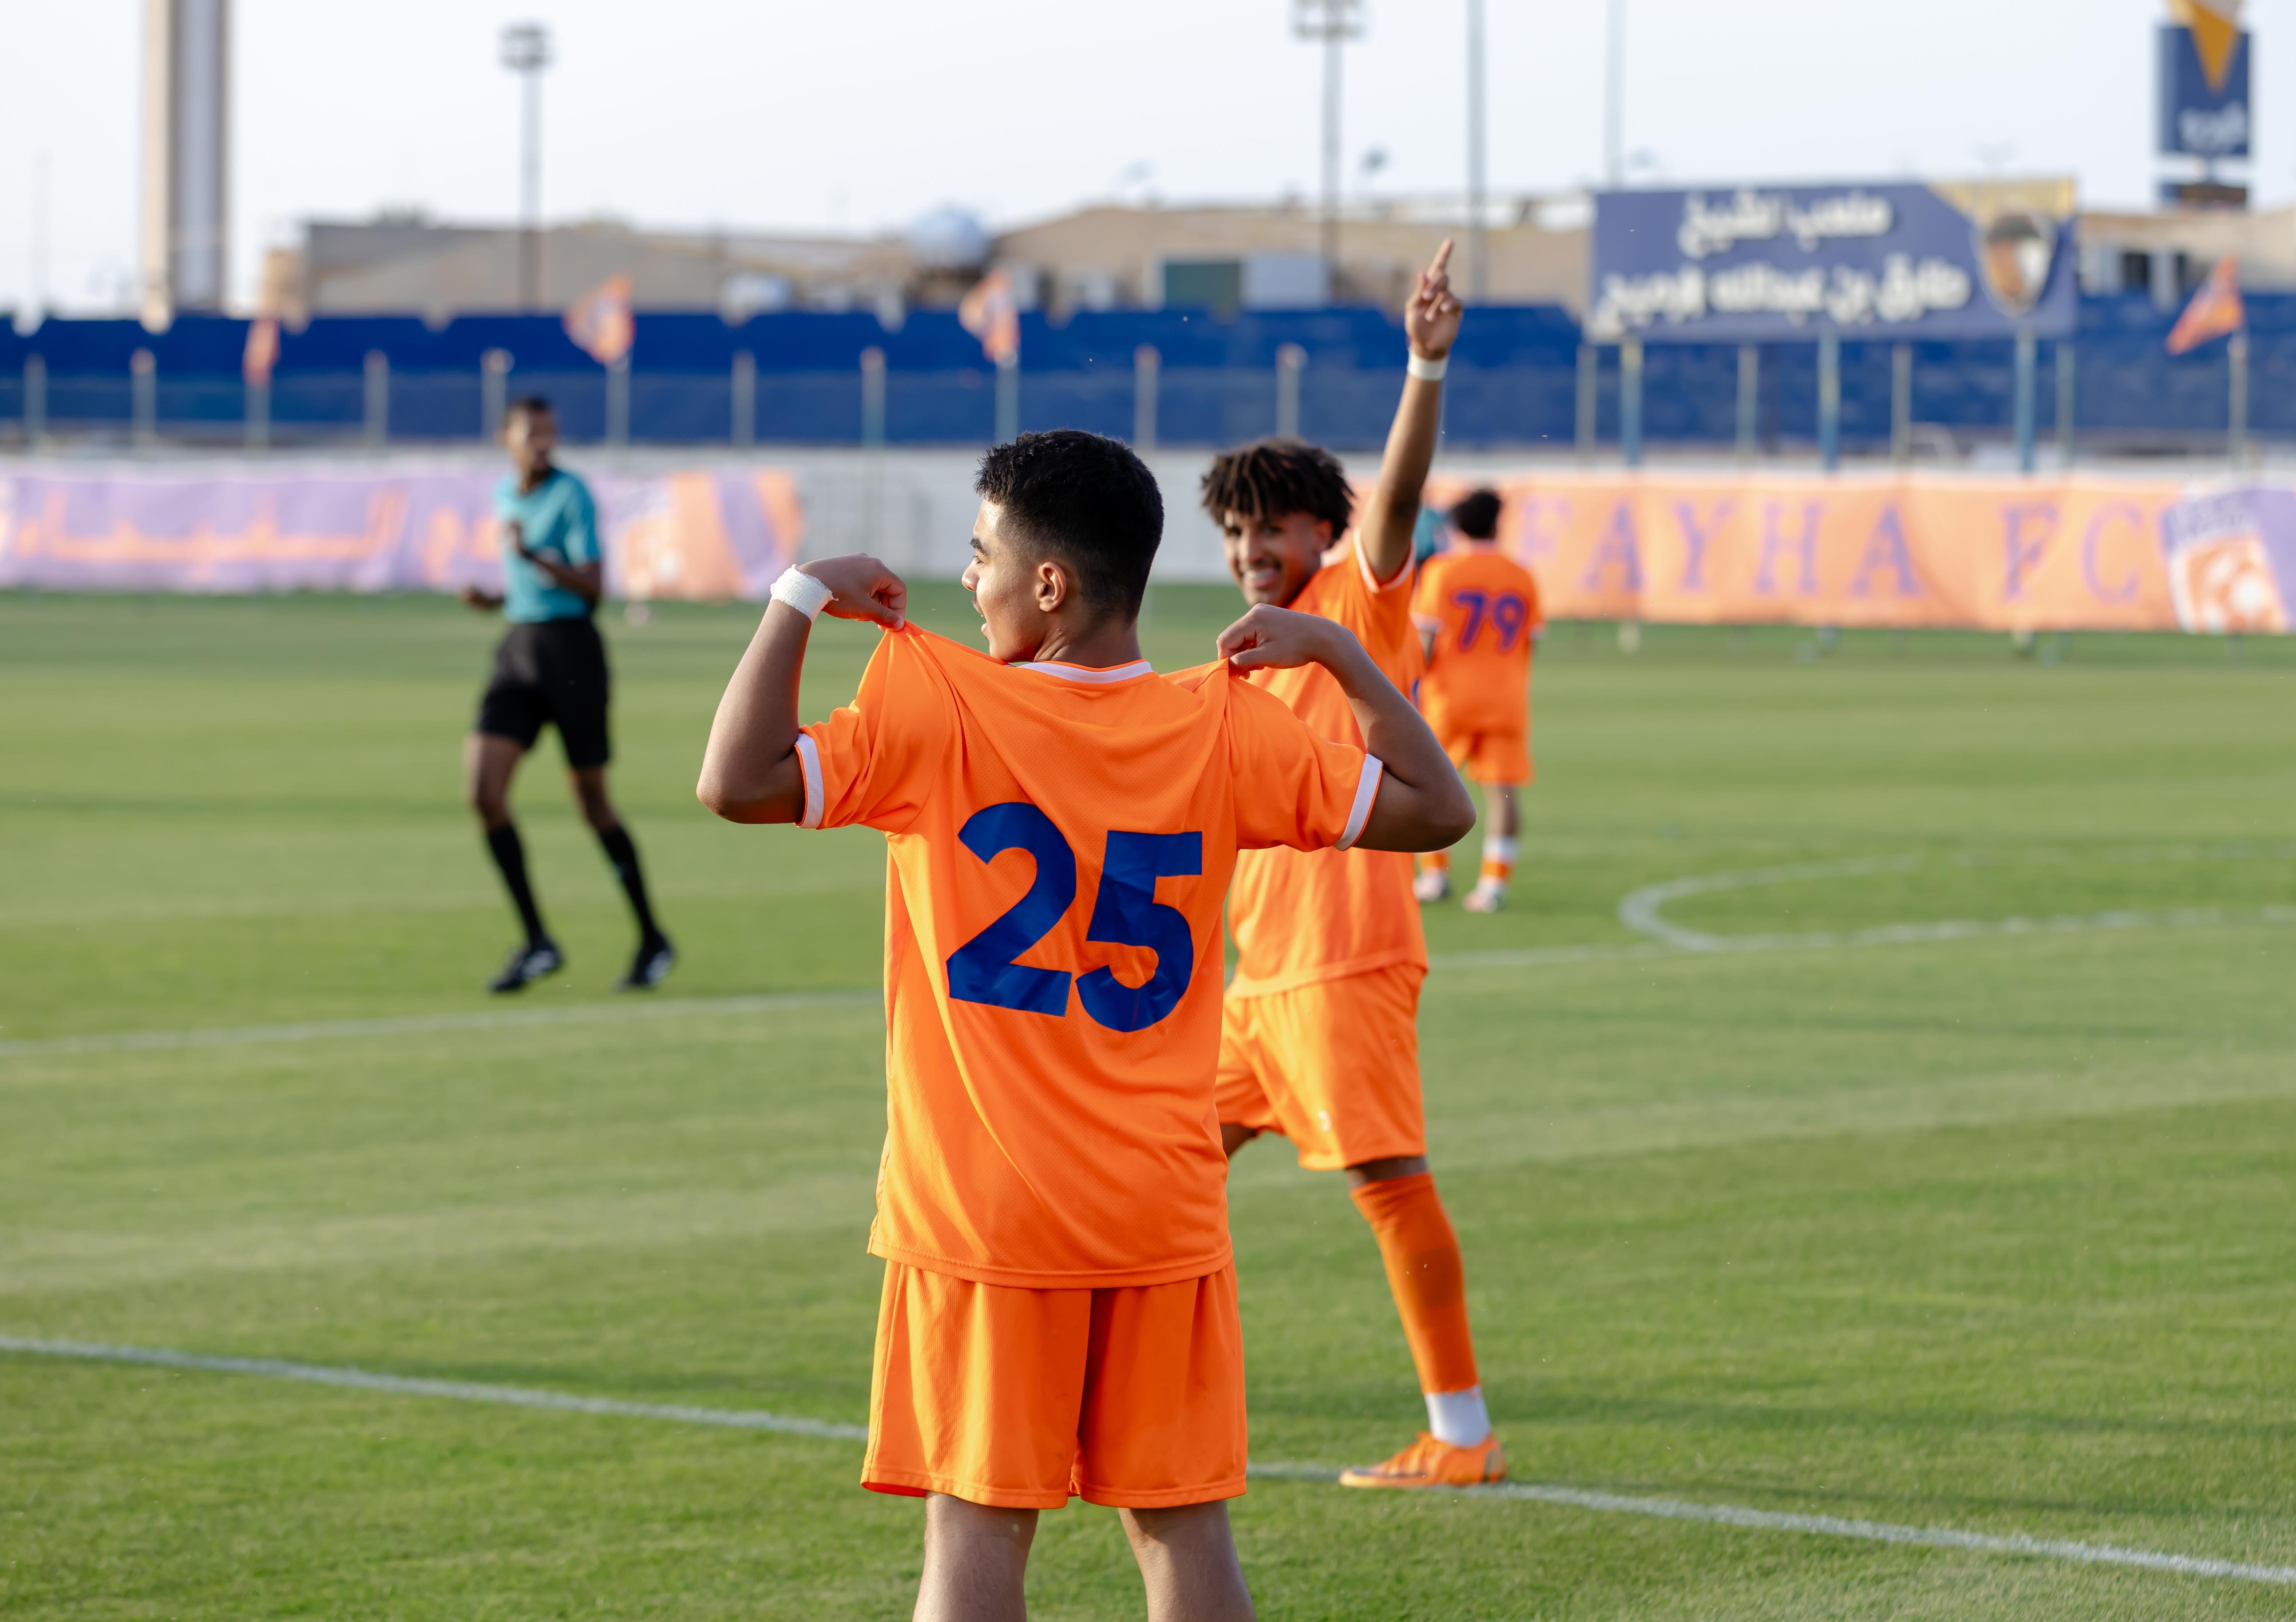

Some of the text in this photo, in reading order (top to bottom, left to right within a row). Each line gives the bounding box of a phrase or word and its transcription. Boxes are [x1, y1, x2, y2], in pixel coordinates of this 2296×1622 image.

[1519, 495, 1929, 599] FAYHA
[1996, 498, 2146, 604] FC
[1453, 590, 1526, 650] 79
[946, 802, 1202, 1032] 25
